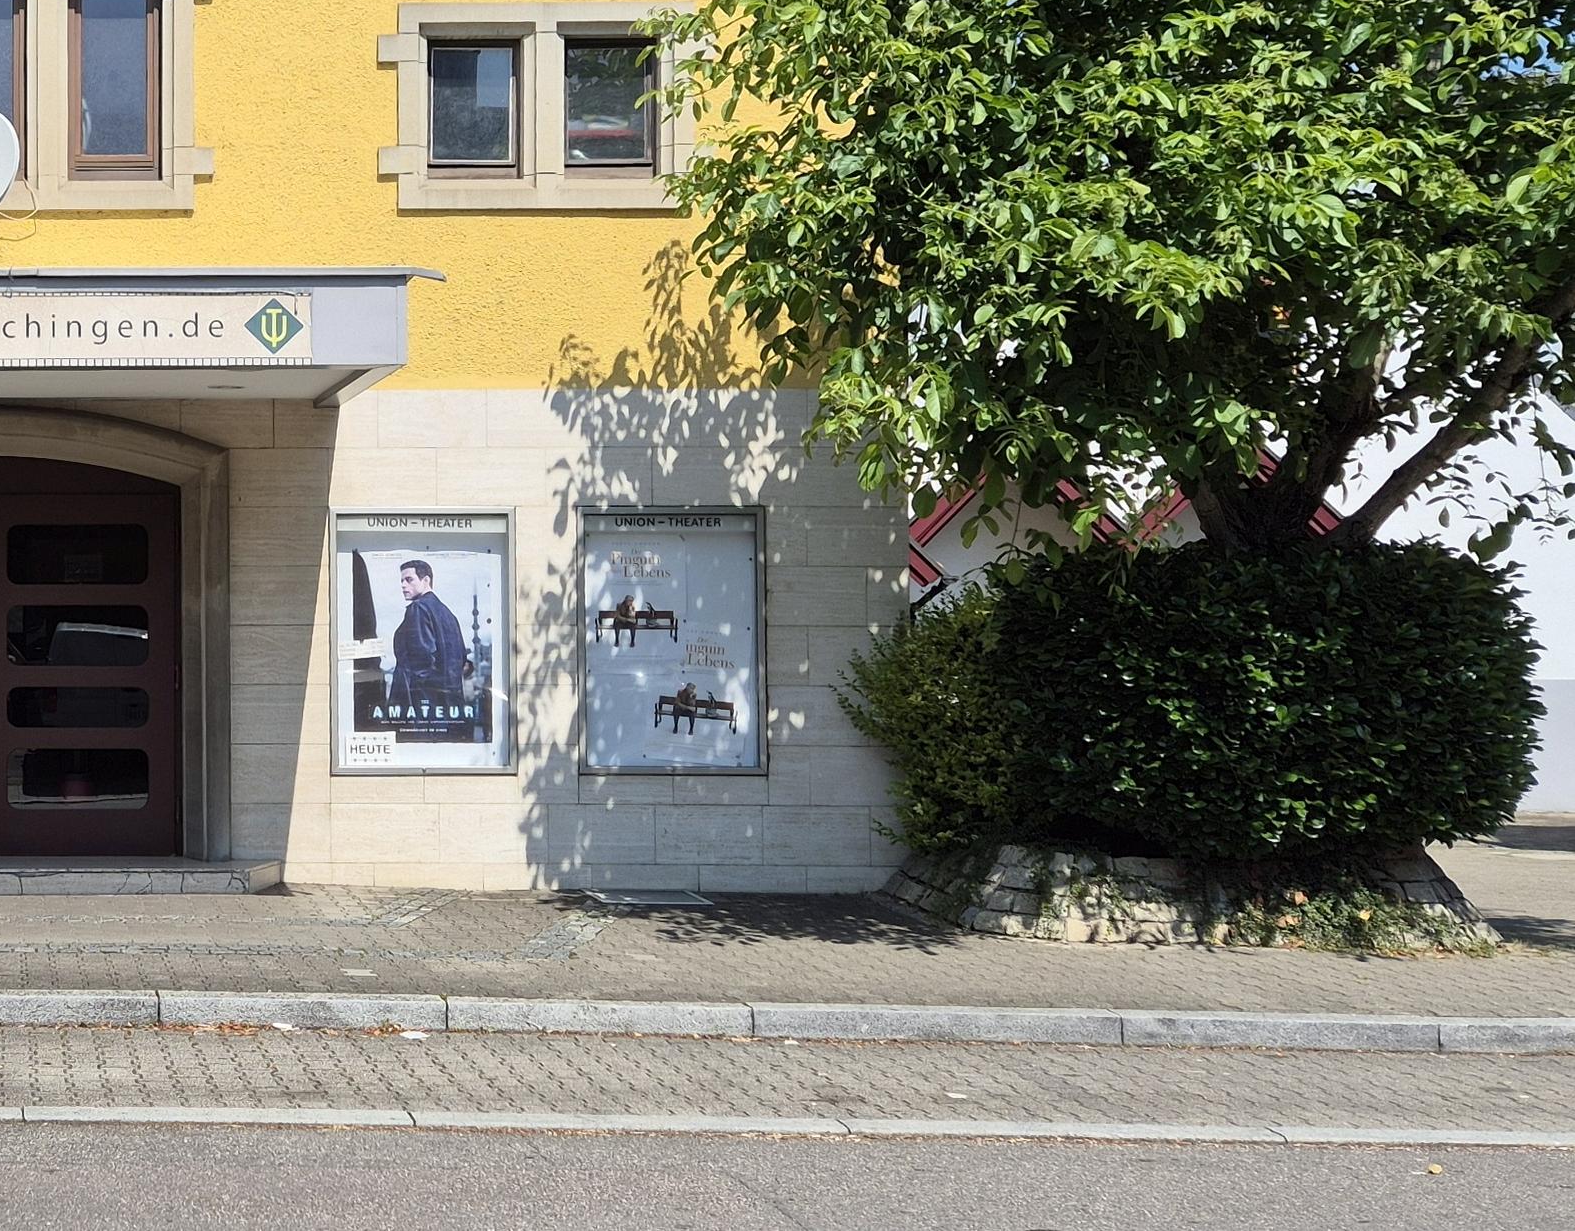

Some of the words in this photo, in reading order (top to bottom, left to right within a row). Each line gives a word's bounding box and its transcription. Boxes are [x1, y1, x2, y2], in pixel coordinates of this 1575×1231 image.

[624, 565, 671, 578] Lebens
[688, 653, 735, 669] Lebens
[373, 705, 474, 718] AMATEUR
[350, 744, 391, 754] HEUTE
